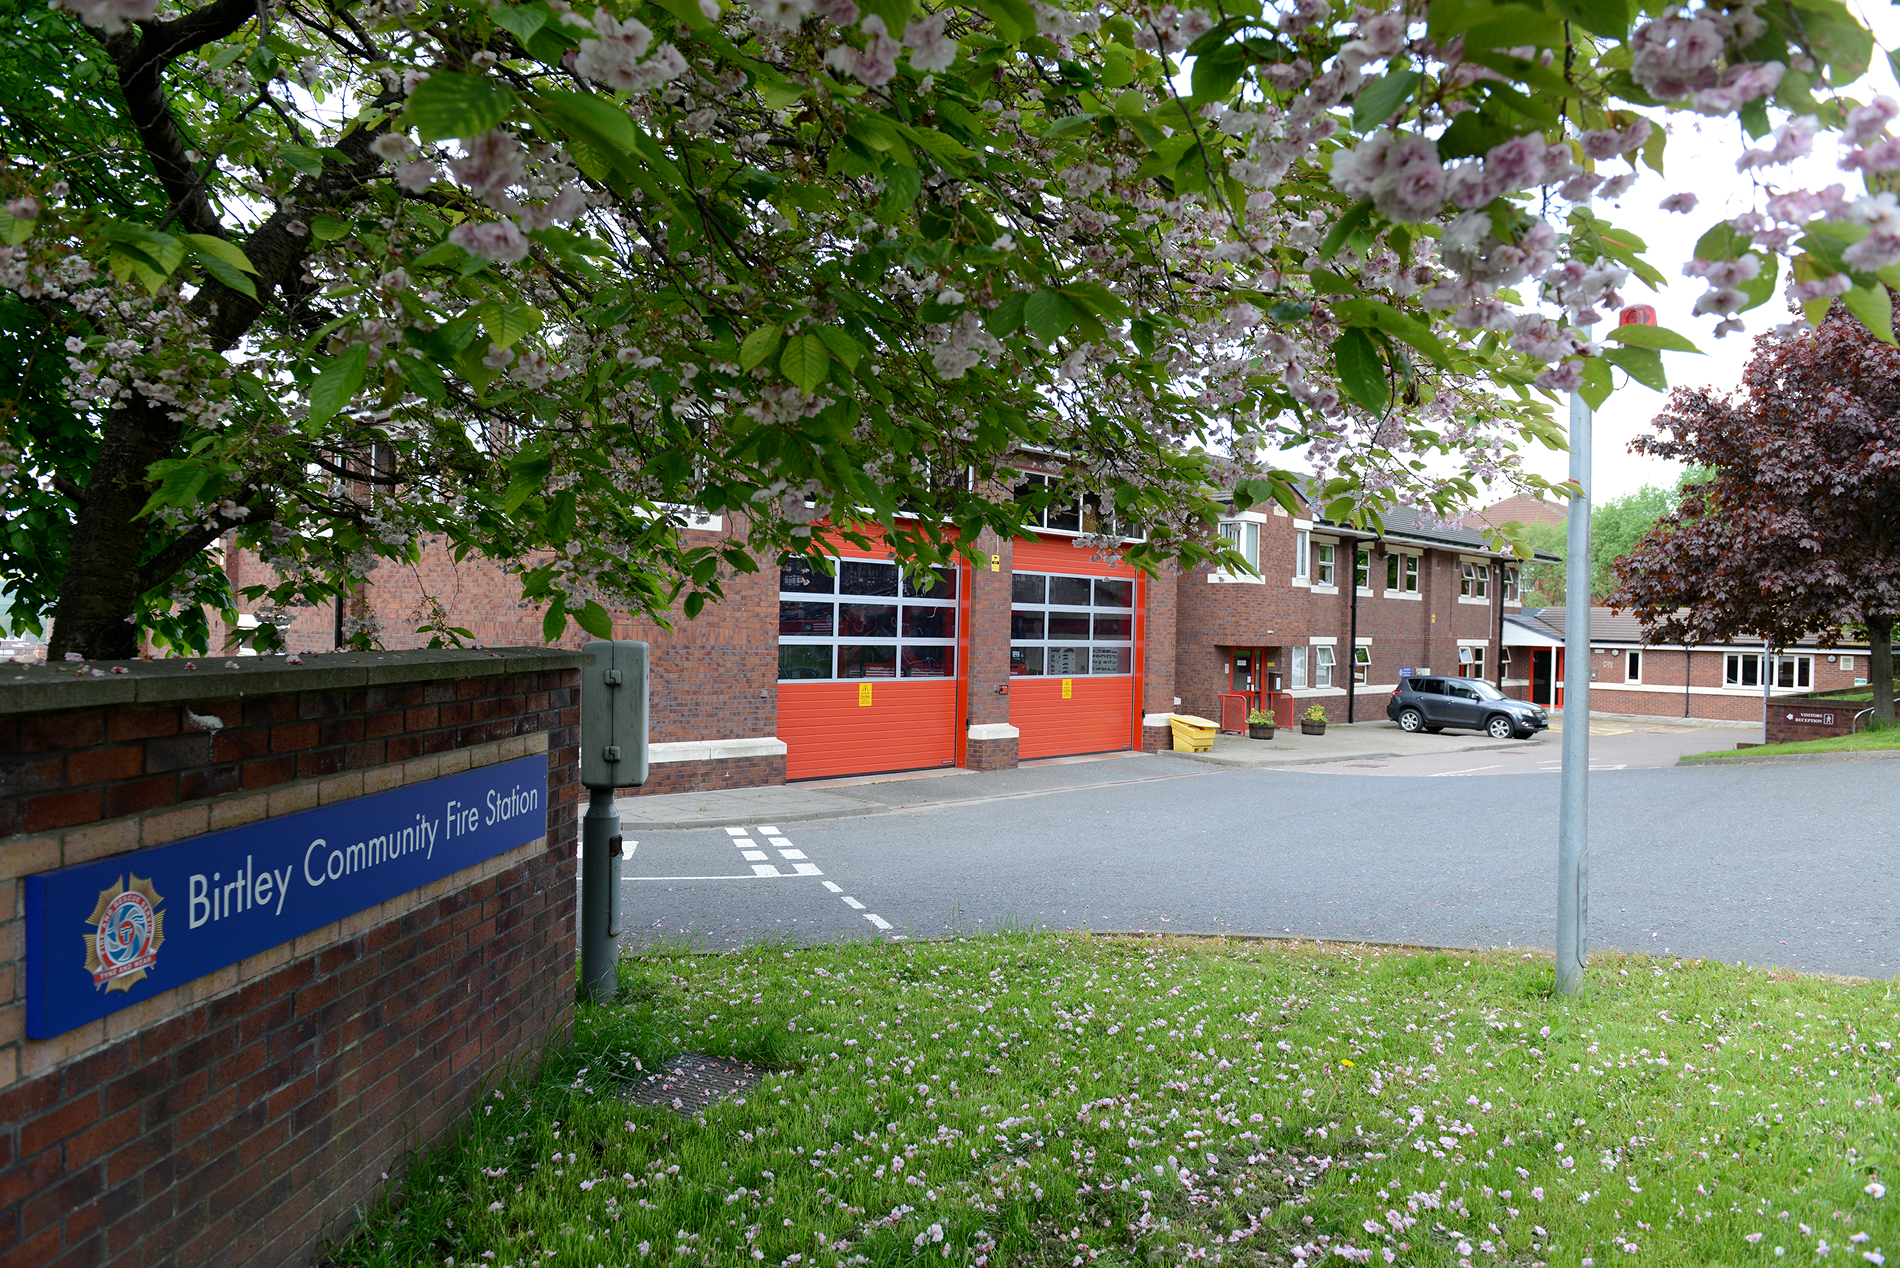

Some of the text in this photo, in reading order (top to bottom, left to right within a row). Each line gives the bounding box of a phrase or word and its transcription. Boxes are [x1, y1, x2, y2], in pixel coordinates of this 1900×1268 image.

[189, 784, 538, 929] Birtley Community Fire Station
[102, 909, 113, 929] AND
[113, 895, 140, 907] RESCUE
[141, 901, 152, 938] SERVICE
[100, 956, 152, 981] TYNE AND WEAR
